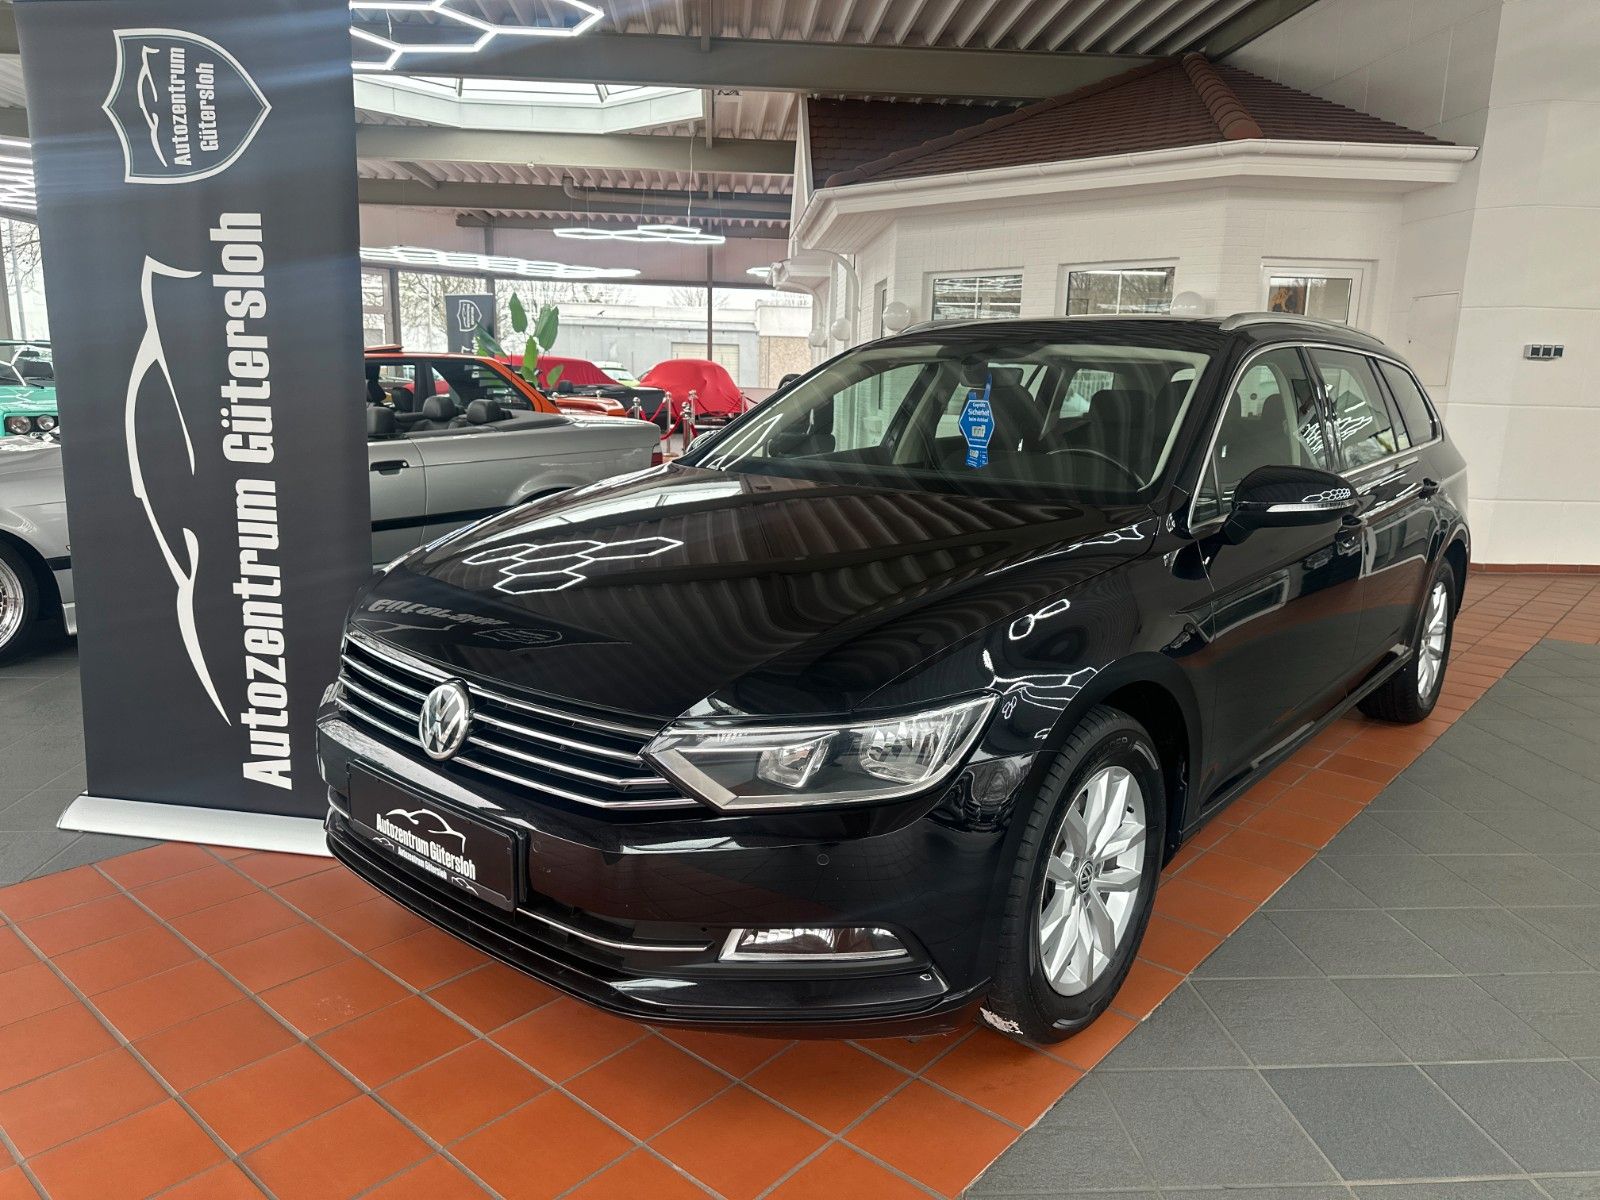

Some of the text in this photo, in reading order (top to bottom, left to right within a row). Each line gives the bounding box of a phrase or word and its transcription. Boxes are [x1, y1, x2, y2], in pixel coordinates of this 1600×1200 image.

[168, 47, 192, 167] Autozentrum
[195, 62, 219, 152] Gütersloh
[209, 212, 292, 790] Autozentrum Gütersloh
[376, 812, 476, 880] Autozentrum Gütersloh
